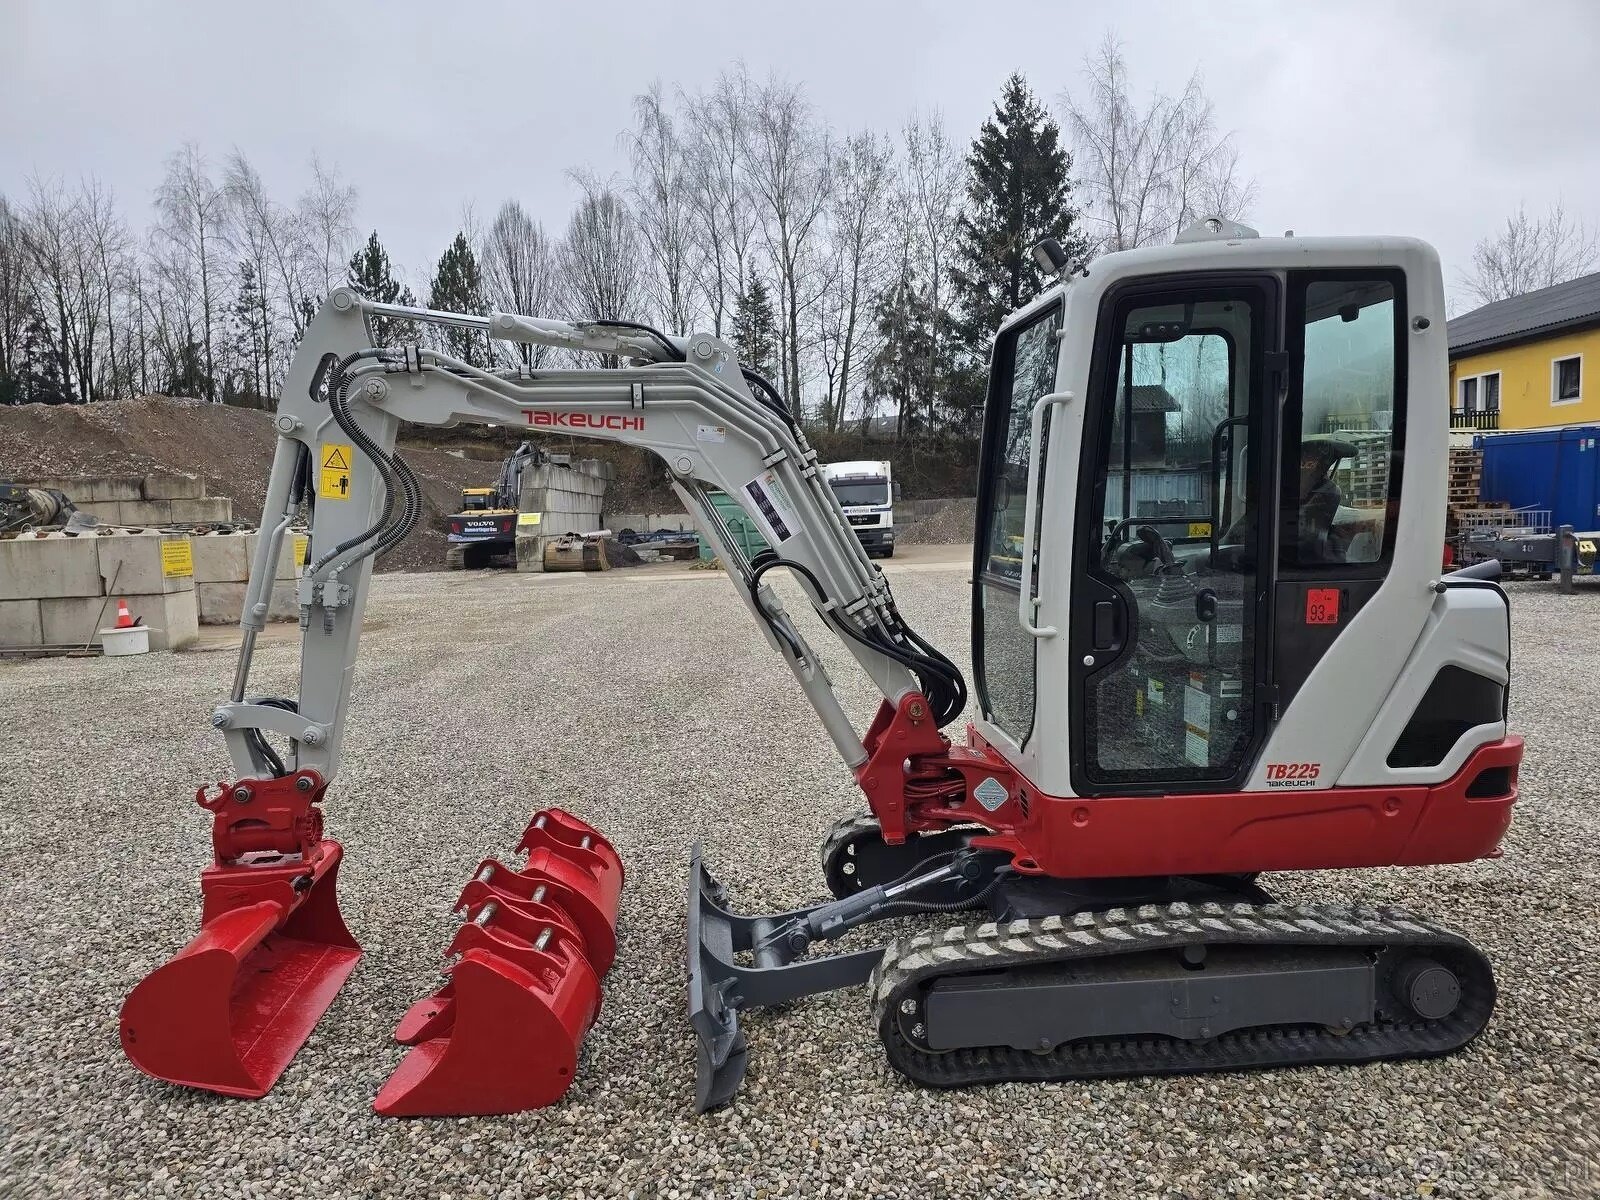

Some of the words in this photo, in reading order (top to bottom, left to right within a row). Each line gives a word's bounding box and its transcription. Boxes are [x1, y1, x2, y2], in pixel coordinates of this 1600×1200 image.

[521, 409, 645, 431] TAKEUCHI
[1310, 604, 1325, 621] 93
[1266, 763, 1321, 779] TB225
